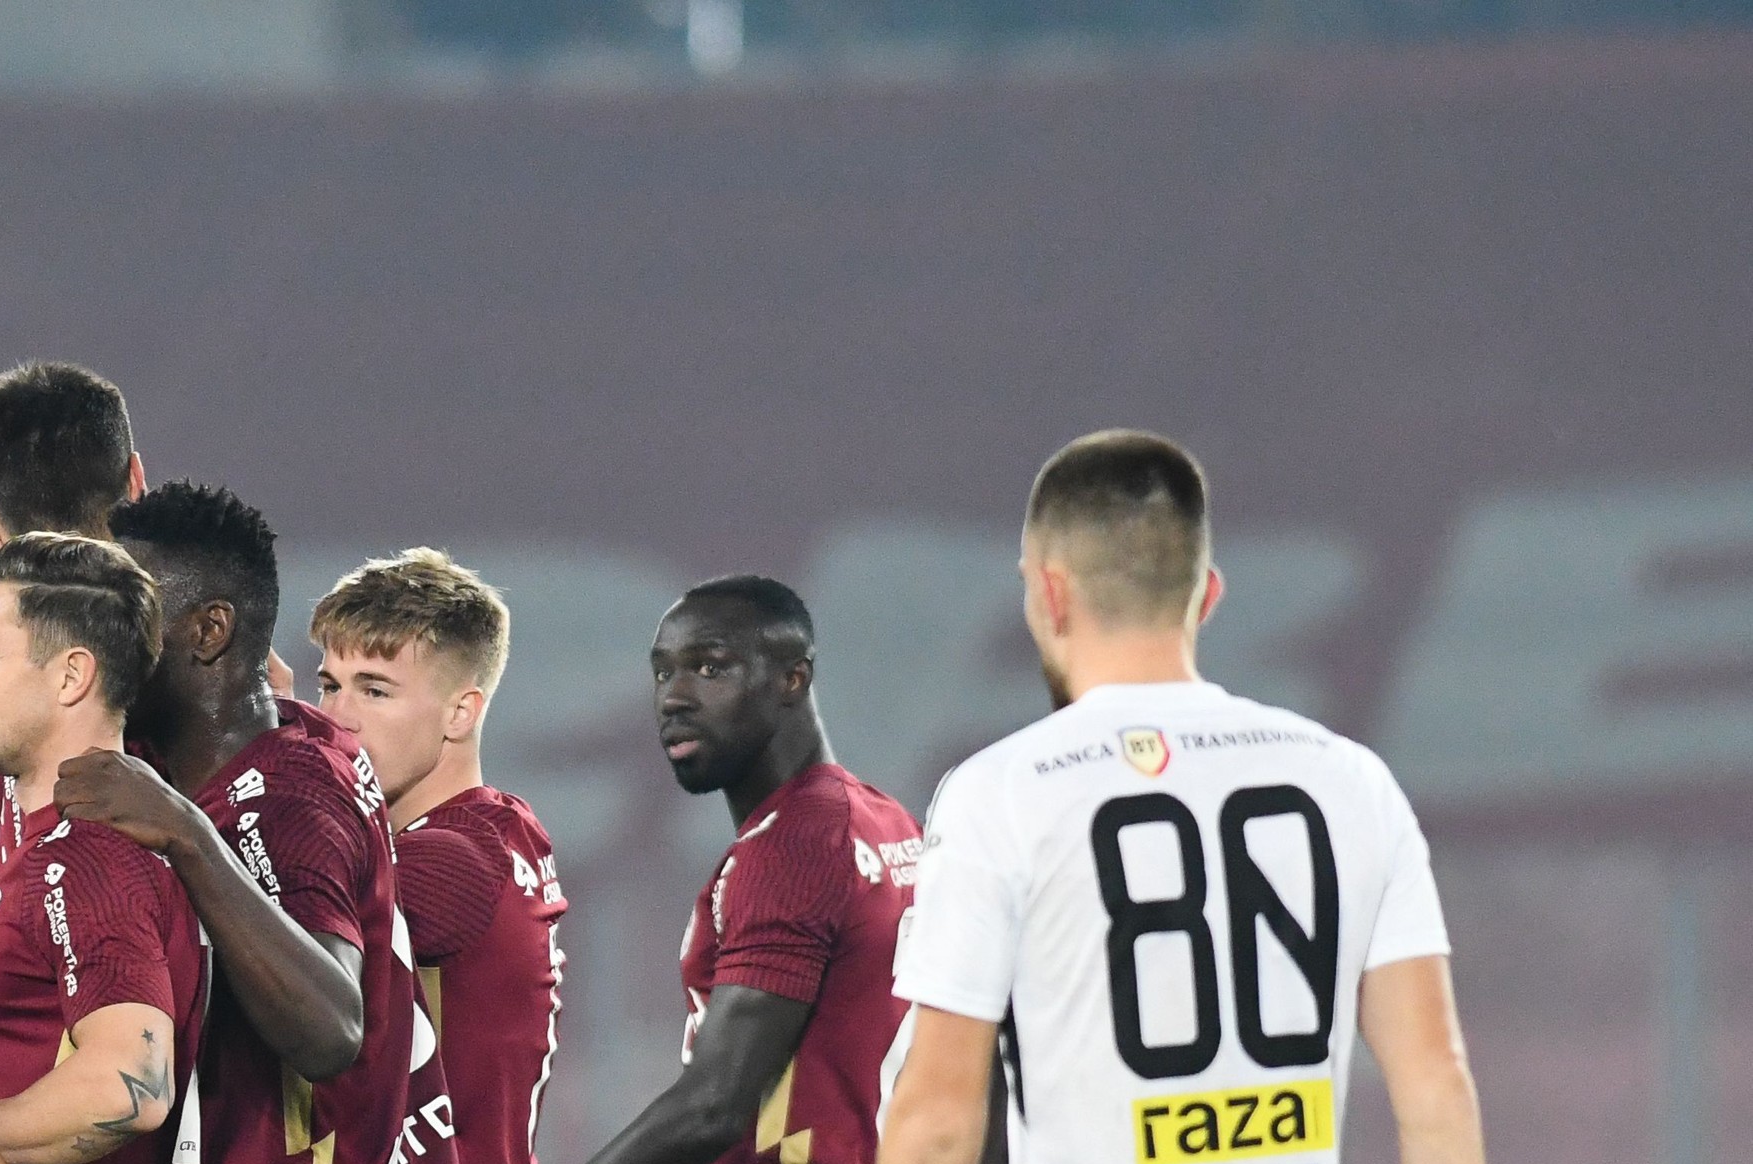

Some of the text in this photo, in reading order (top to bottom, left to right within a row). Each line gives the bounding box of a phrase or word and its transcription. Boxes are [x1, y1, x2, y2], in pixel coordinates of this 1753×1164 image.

[44, 893, 62, 946] CASINO
[1091, 783, 1340, 1080] 80
[1142, 1090, 1307, 1160] raza
